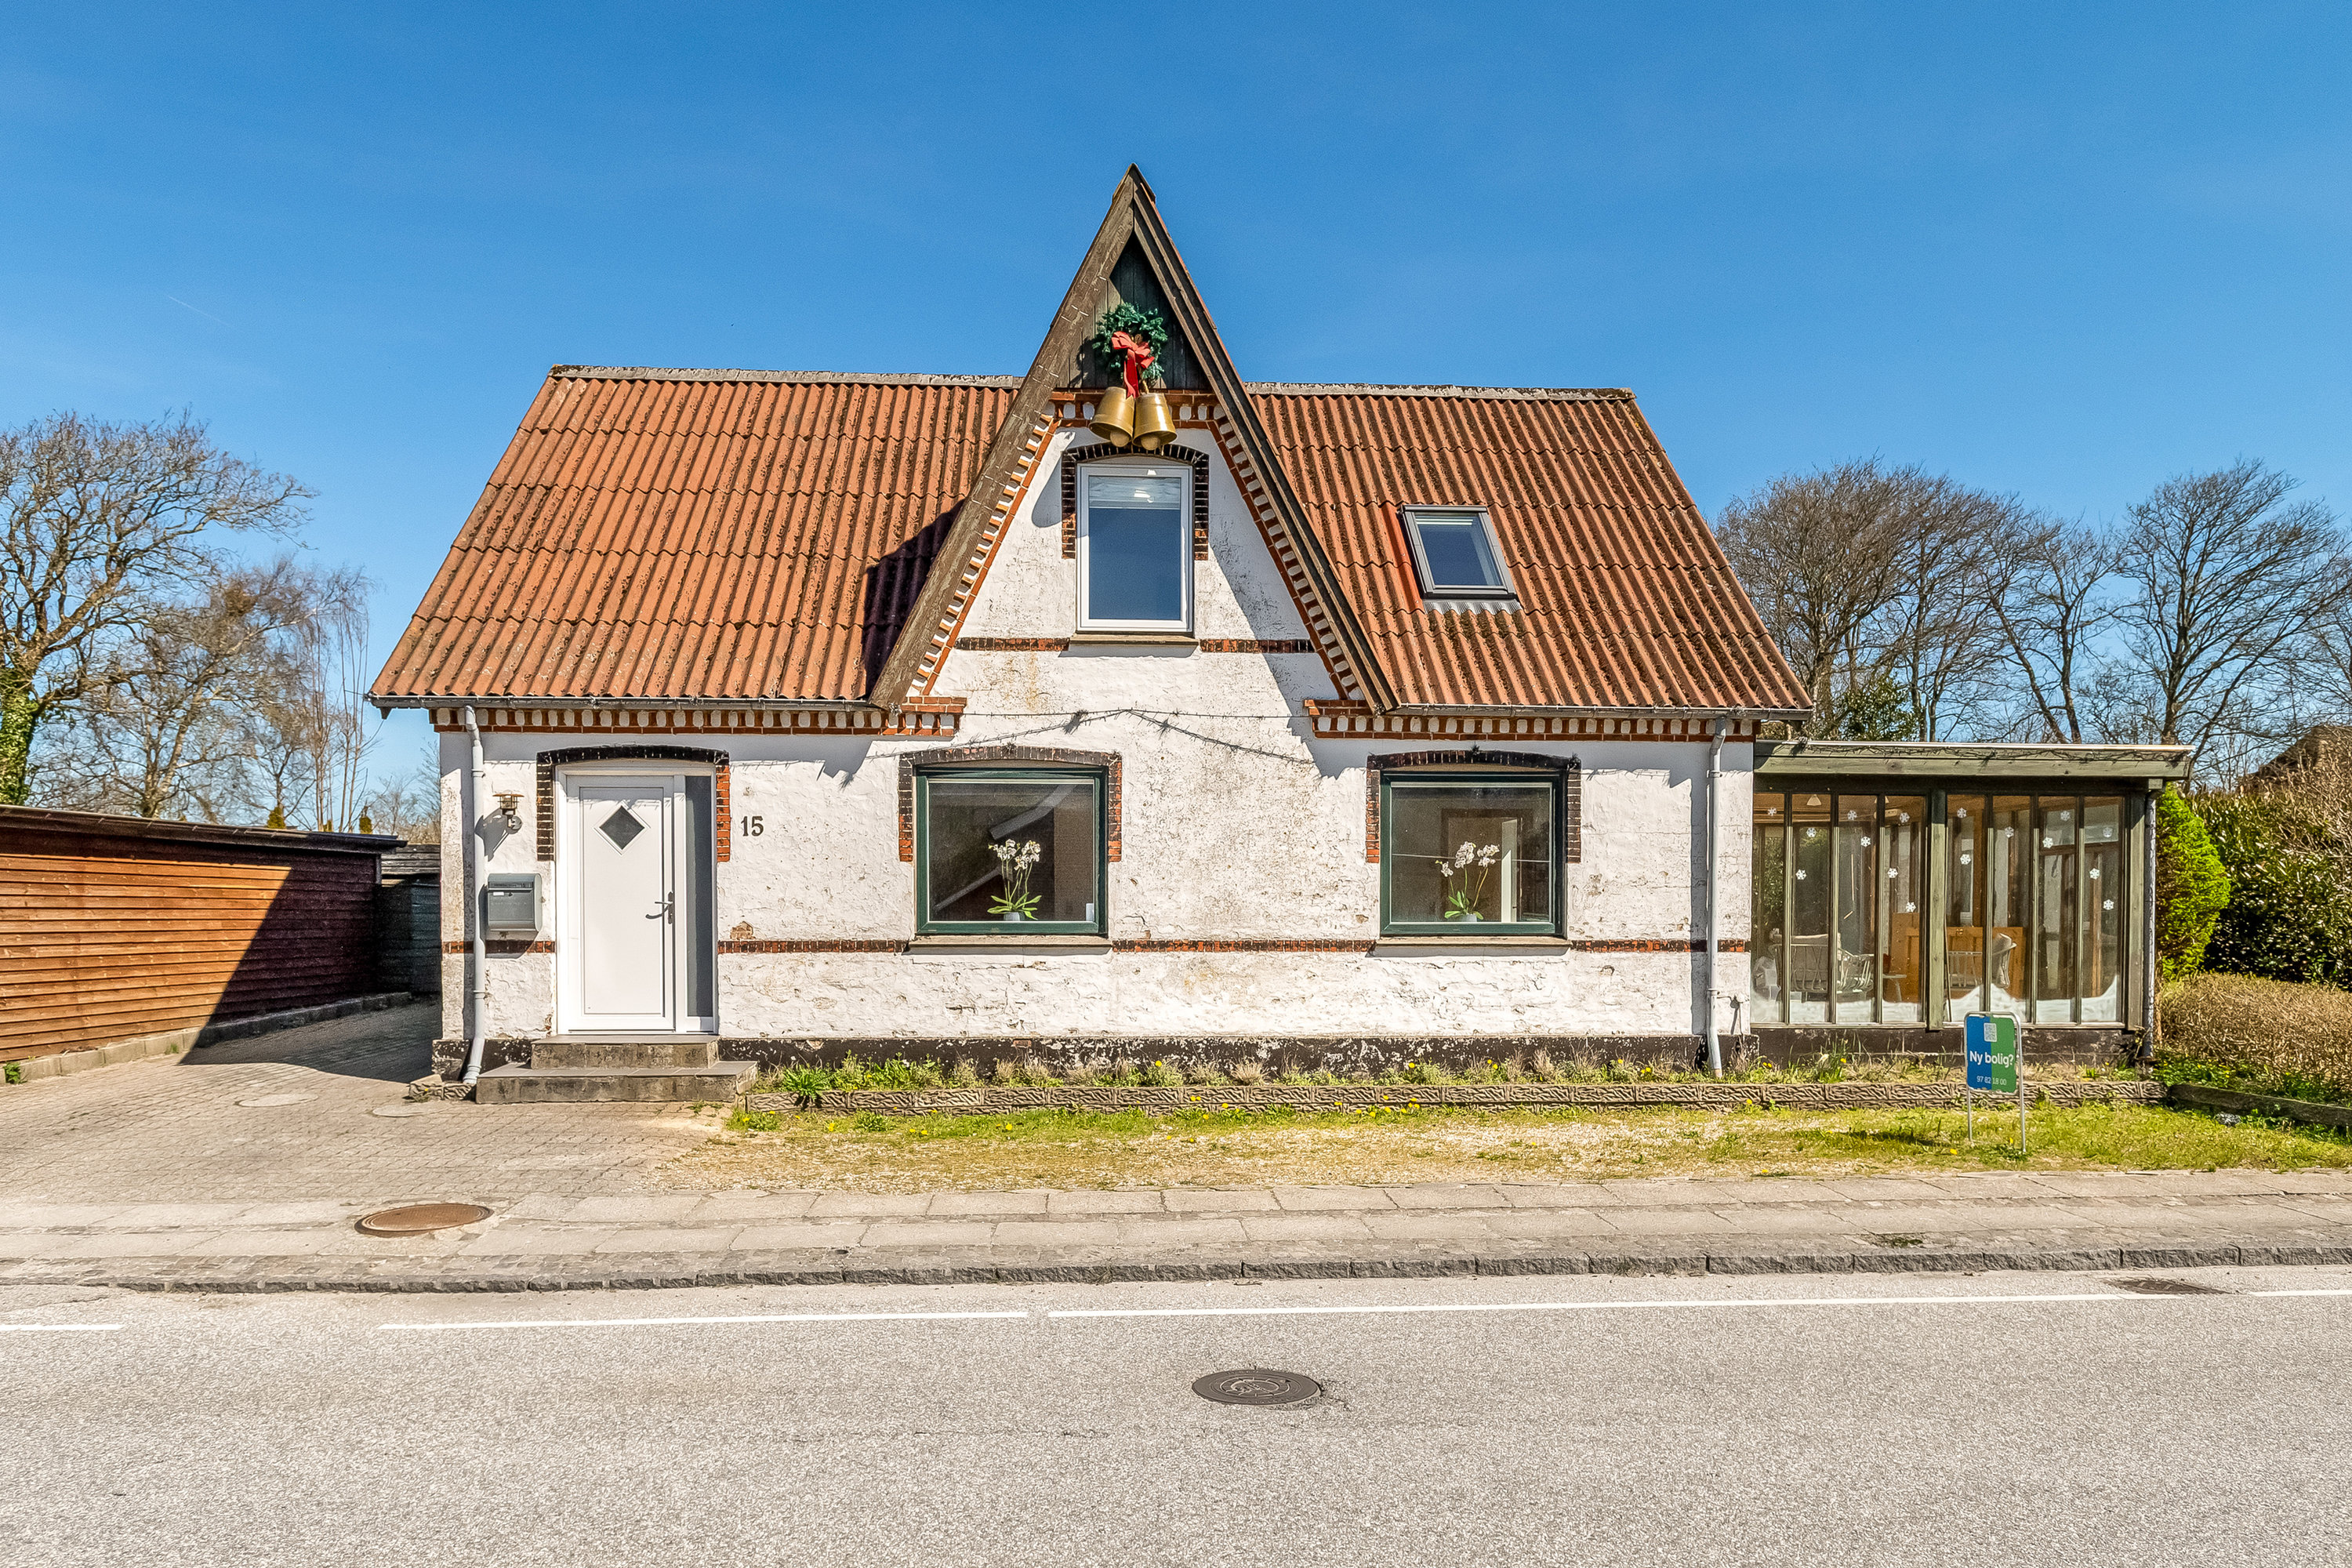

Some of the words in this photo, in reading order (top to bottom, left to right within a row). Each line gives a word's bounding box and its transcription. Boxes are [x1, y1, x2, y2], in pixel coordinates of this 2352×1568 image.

[741, 815, 764, 837] 15
[1969, 1050, 1983, 1065] Ny
[1984, 1051, 2014, 1068] bolig?
